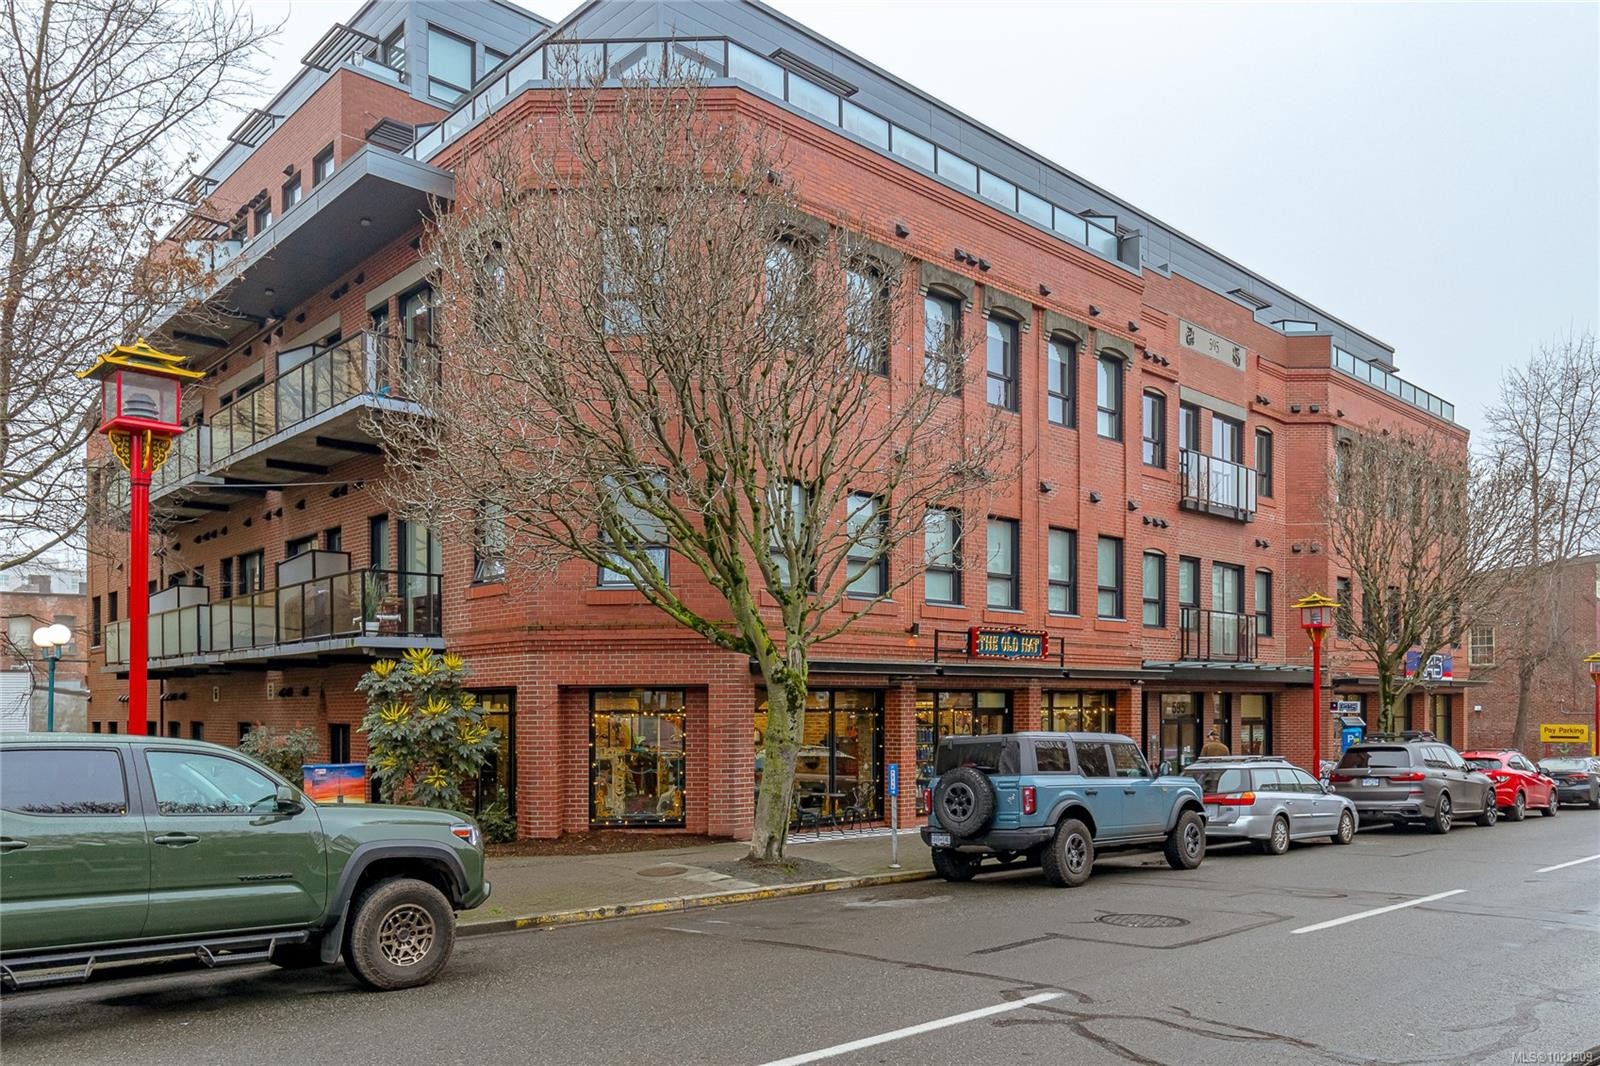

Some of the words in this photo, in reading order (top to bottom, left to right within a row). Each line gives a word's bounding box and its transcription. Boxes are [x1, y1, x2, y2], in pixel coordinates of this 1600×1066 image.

[978, 635, 999, 651] THE
[1001, 636, 1018, 652] OLD
[1021, 637, 1040, 653] HAT
[1172, 702, 1186, 714] 595
[1558, 727, 1585, 735] Parking
